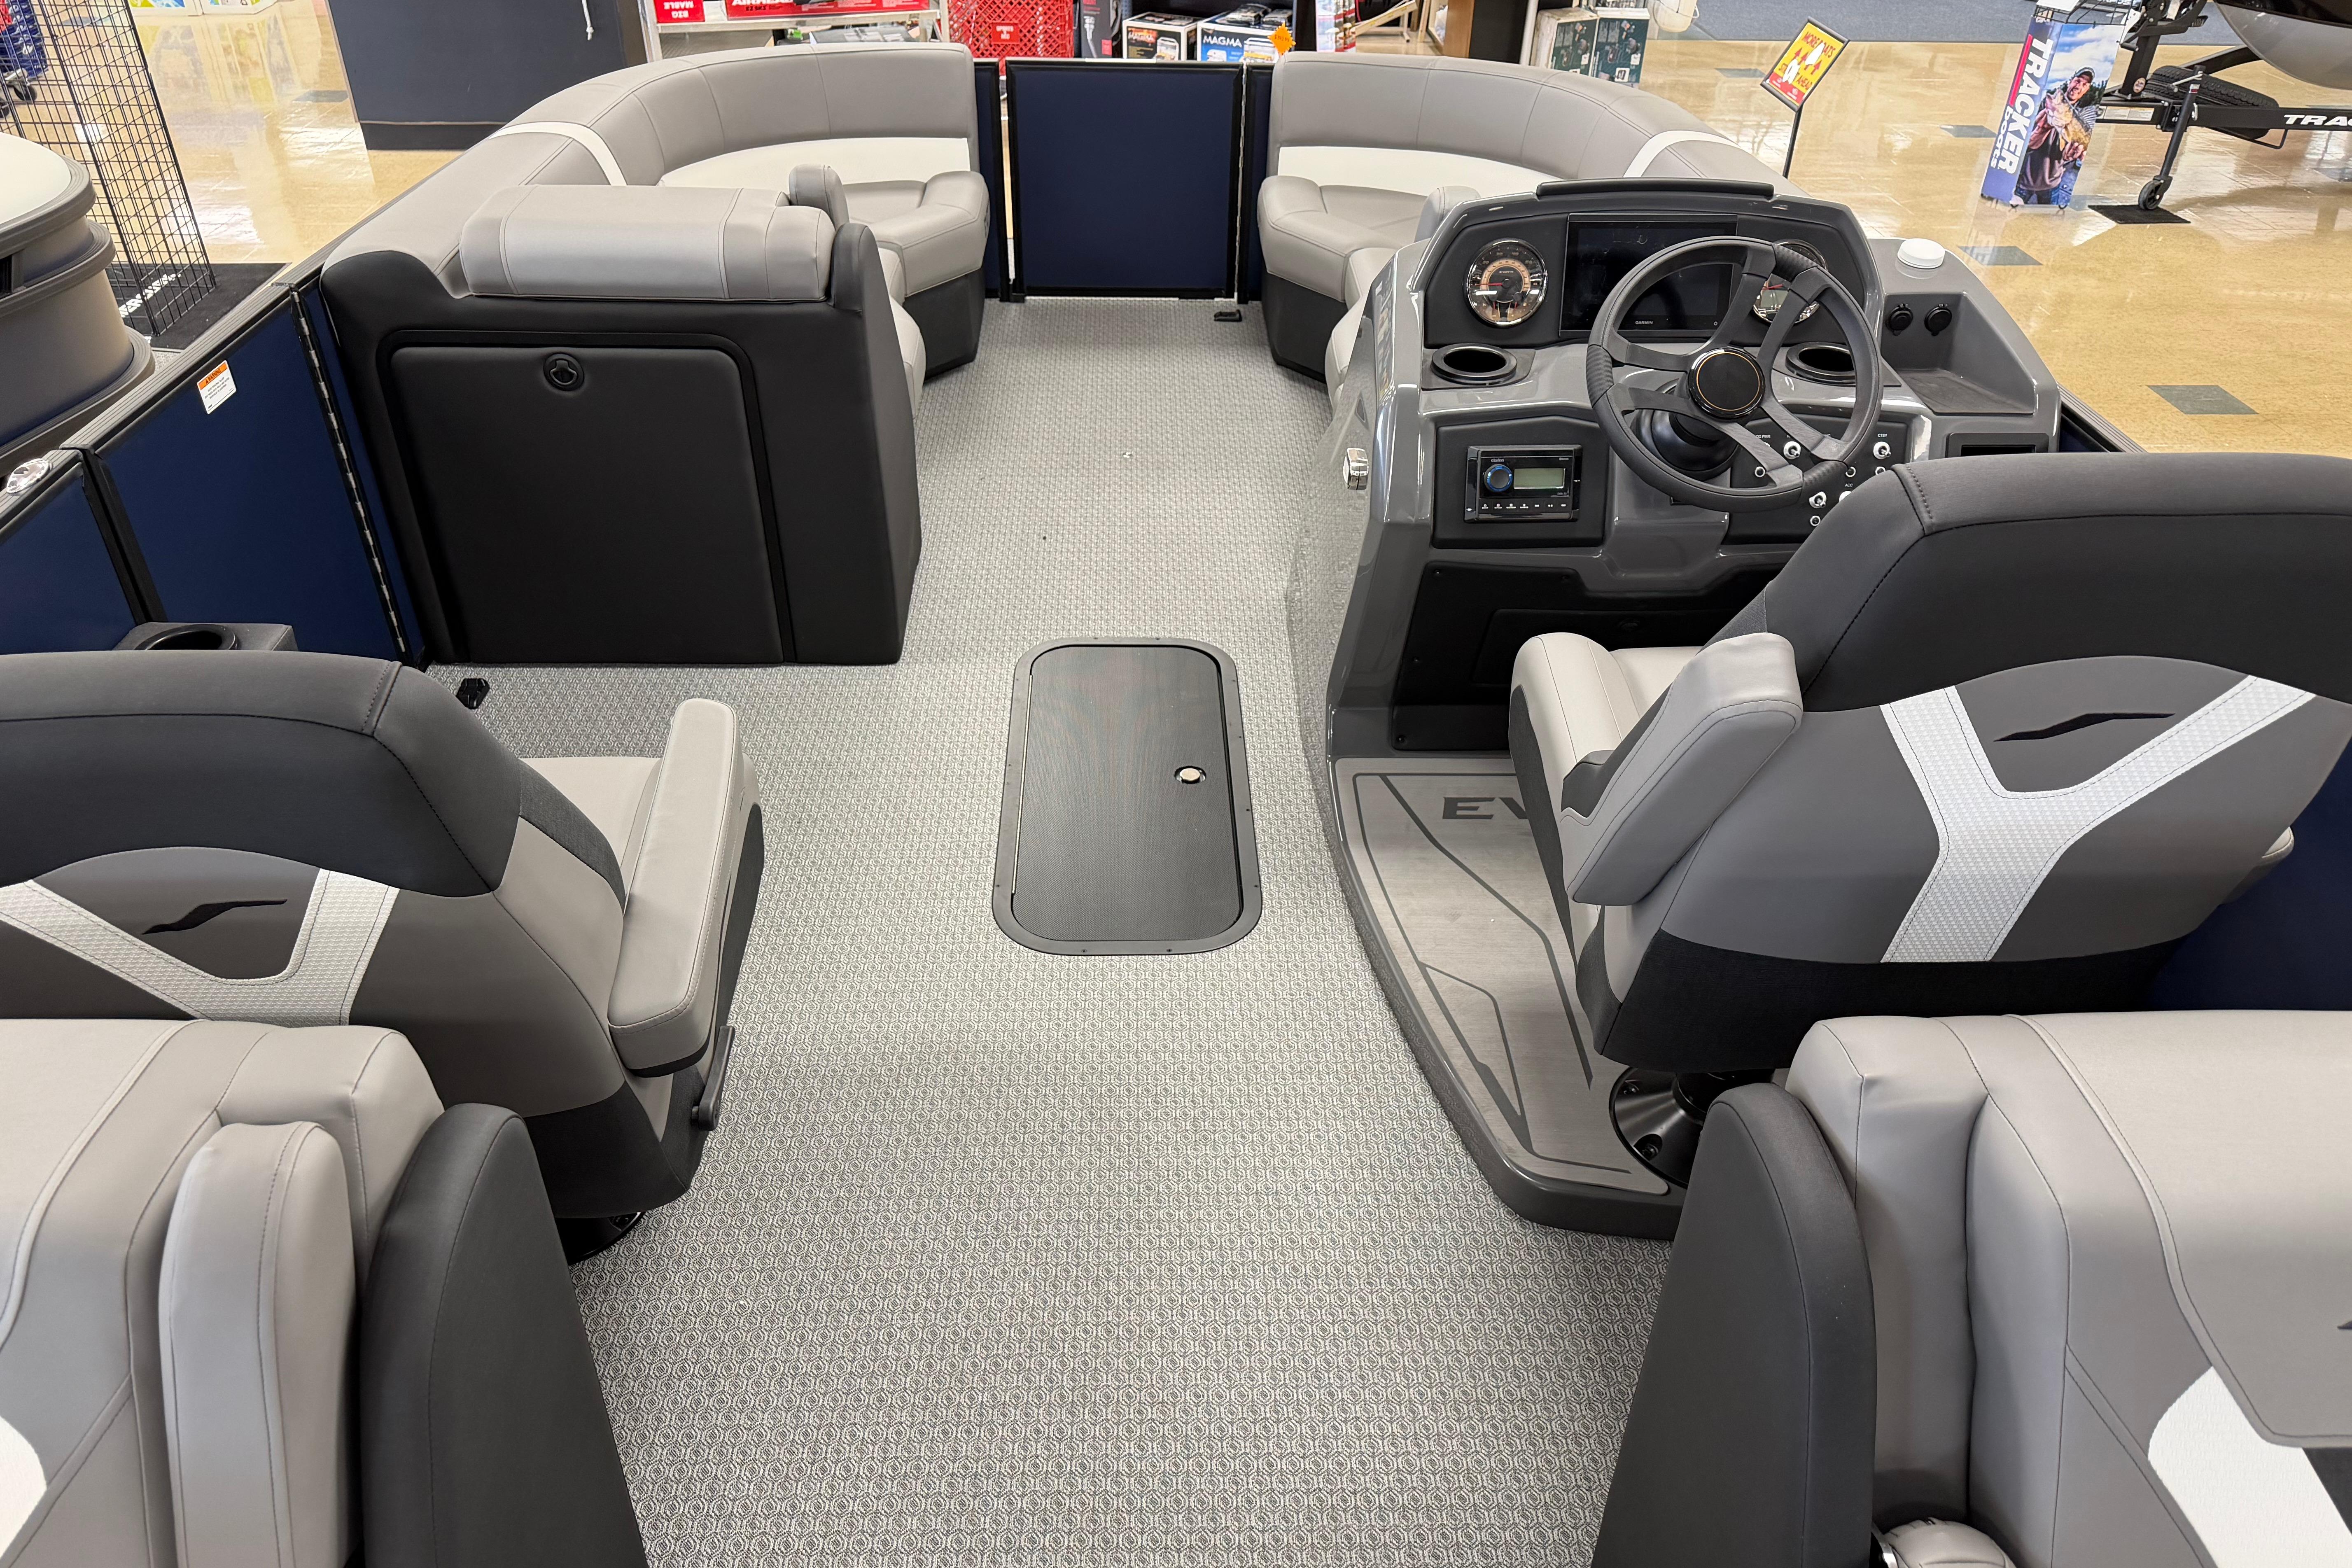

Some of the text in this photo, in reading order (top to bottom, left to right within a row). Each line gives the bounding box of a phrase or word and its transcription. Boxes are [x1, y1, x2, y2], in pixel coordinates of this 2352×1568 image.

[663, 1, 694, 10] MABLE
[1203, 35, 1242, 48] MAGMA
[1802, 31, 1820, 48] MORE
[1998, 38, 2053, 174] TRACKER
[2284, 114, 2352, 126] TRA
[1990, 105, 2013, 168] boats
